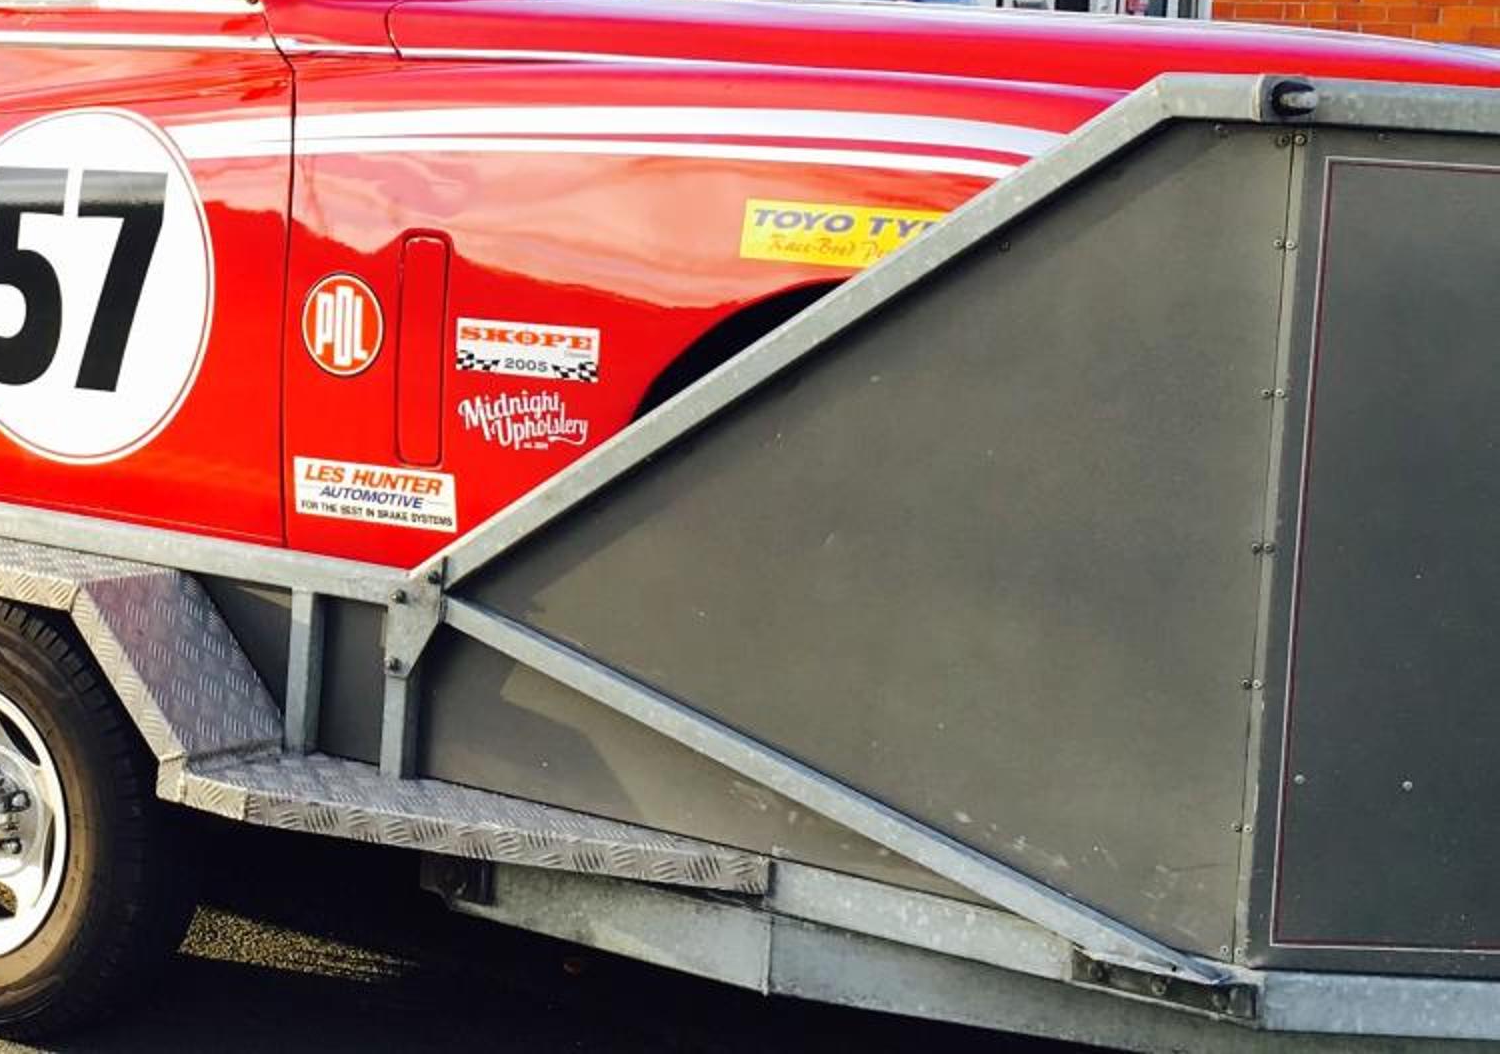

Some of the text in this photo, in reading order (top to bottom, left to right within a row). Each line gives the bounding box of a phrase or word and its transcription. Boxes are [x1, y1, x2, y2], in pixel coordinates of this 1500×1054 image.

[754, 209, 854, 233] TOYO
[315, 285, 369, 367] PDL
[460, 326, 592, 351] SKOPE
[504, 357, 549, 373] 2005
[305, 463, 443, 496] LES HUNTER
[319, 485, 424, 509] AUTOMOTIVE
[301, 499, 453, 527] FOR THE BEST IN BRAKE SYSTEMS
